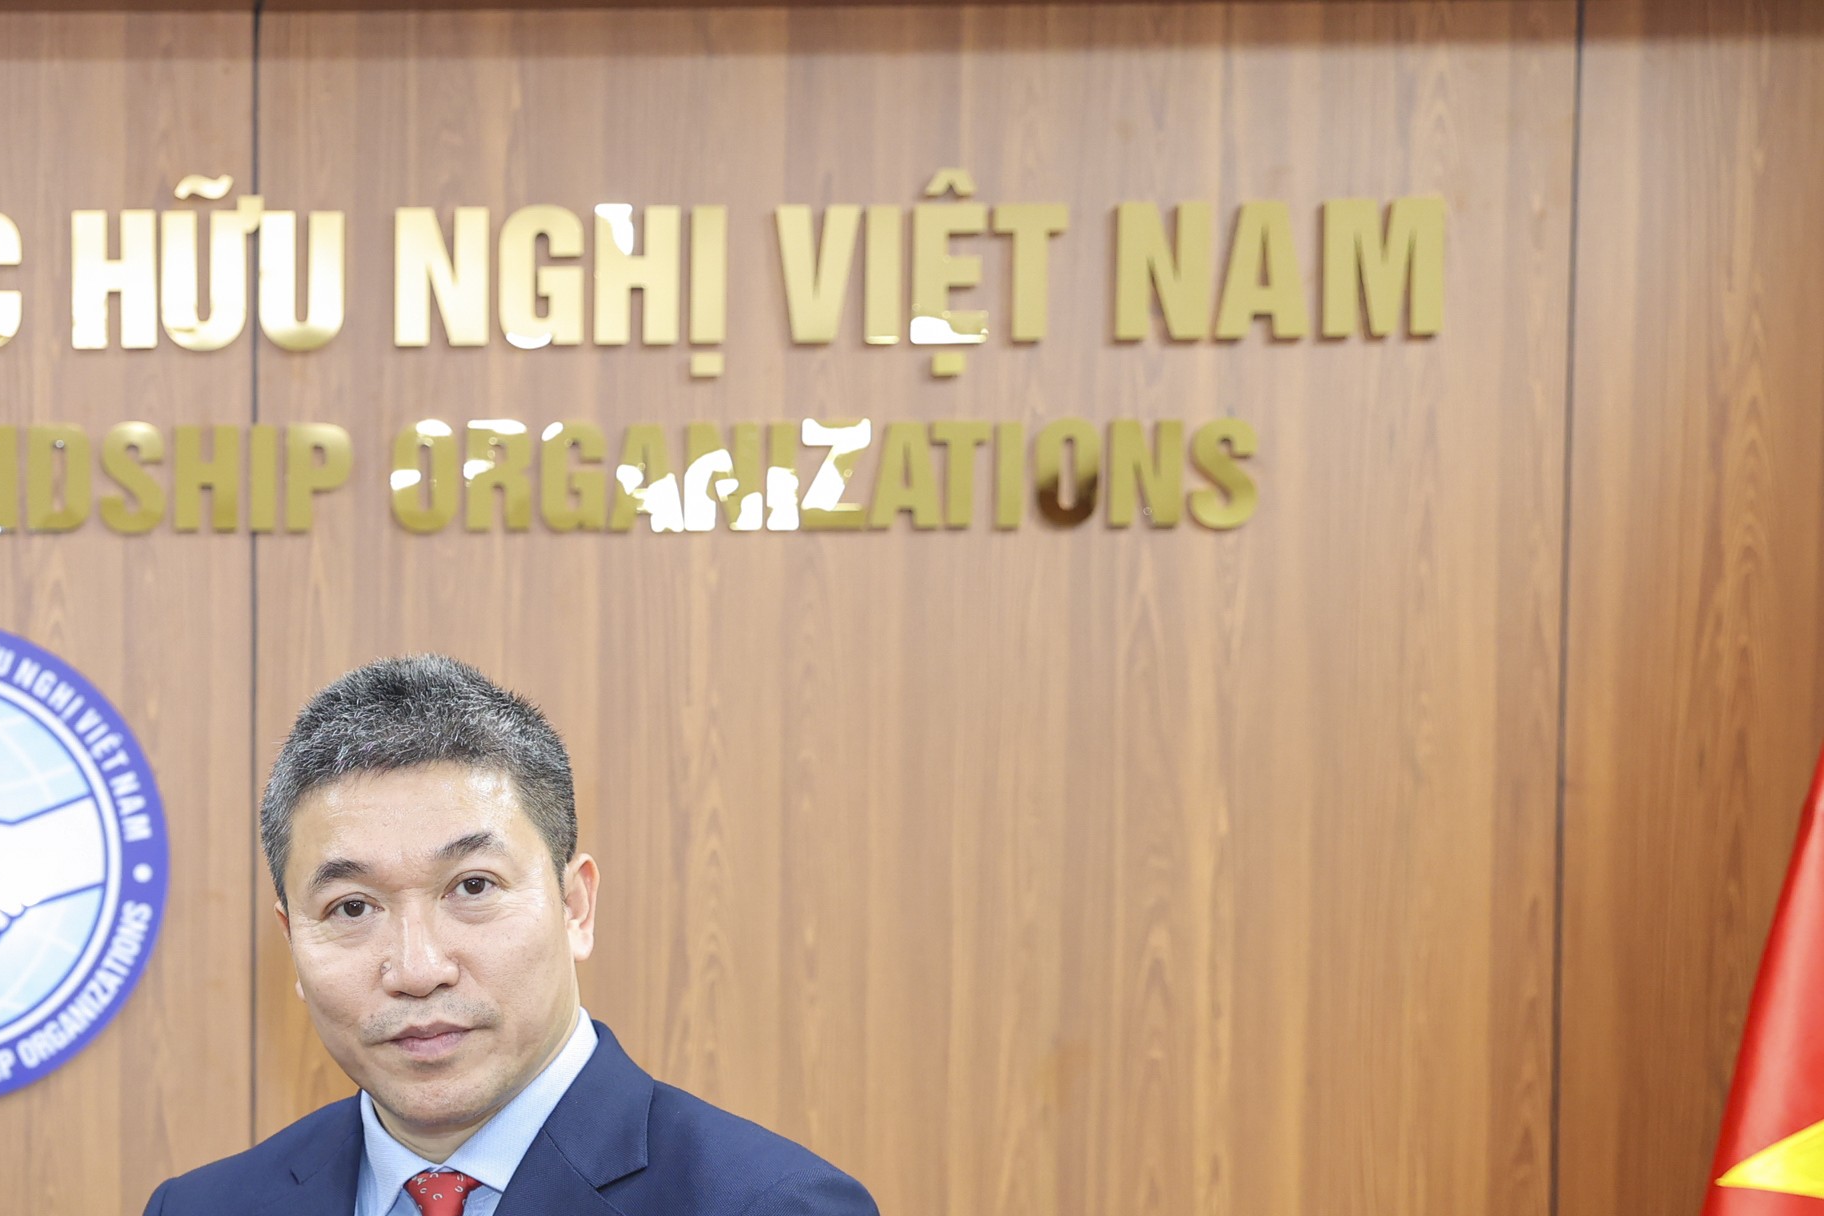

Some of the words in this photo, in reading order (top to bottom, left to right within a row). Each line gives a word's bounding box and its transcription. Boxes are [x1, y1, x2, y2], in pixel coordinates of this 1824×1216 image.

[70, 174, 345, 352] HỮU
[393, 202, 728, 378] NGHỊ
[776, 167, 1070, 377] VIỆT
[1111, 196, 1447, 342] NAM
[390, 417, 1259, 534] ORGANIZATIONS
[108, 770, 153, 843] NAM
[16, 900, 154, 1069] ORGANIZATIONS
